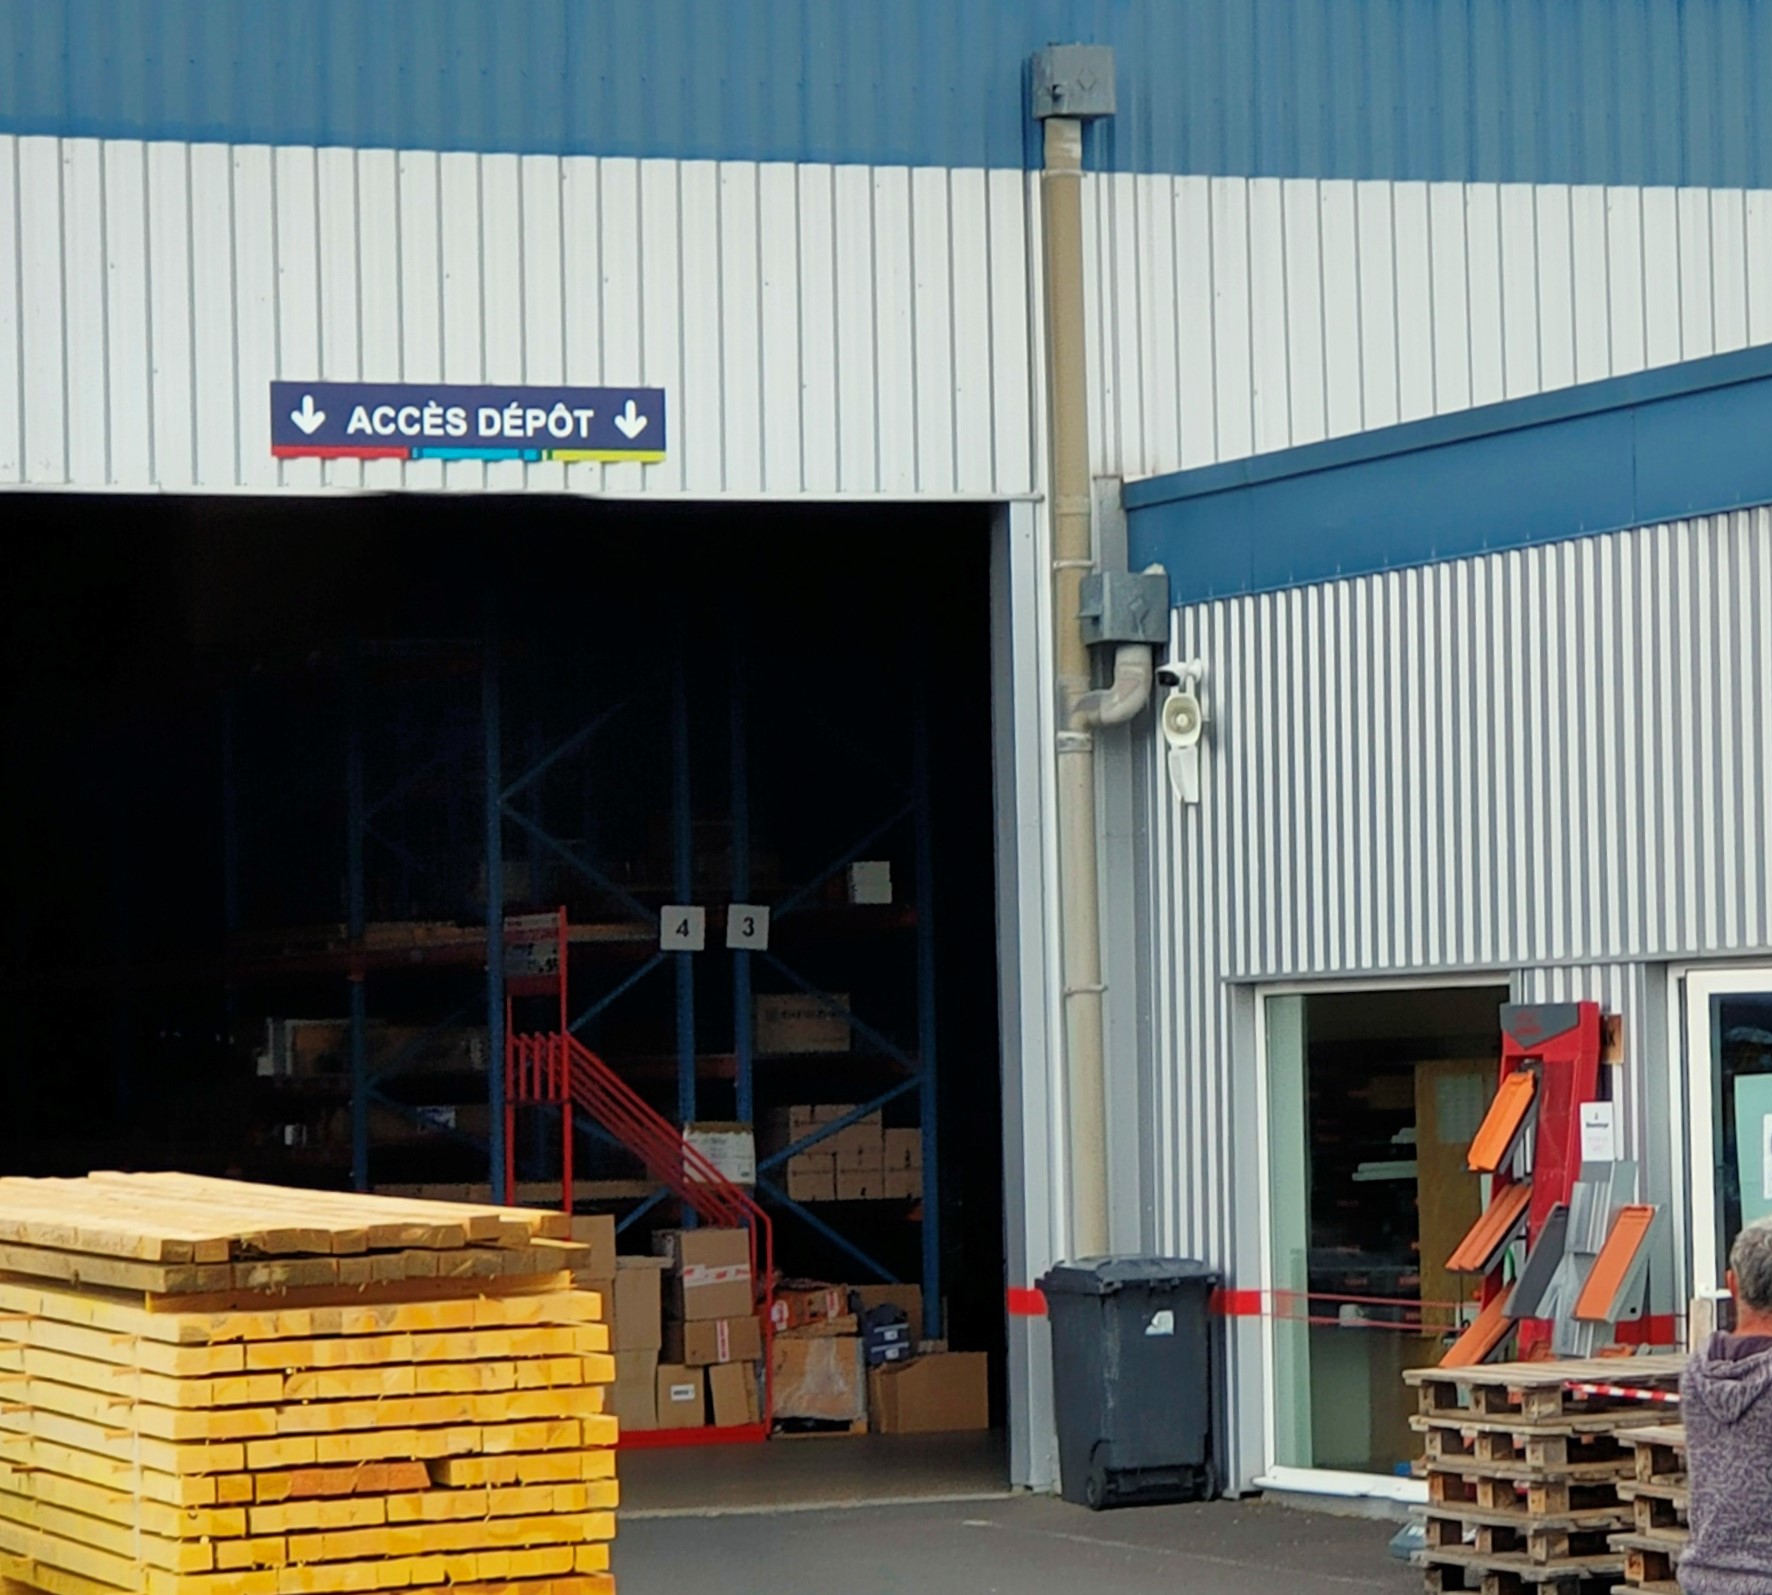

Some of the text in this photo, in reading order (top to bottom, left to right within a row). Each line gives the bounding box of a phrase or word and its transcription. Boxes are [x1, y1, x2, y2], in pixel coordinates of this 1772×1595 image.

[346, 400, 595, 438] ACCÈS DÉPÔT
[676, 918, 689, 938] 4
[742, 916, 754, 937] 3
